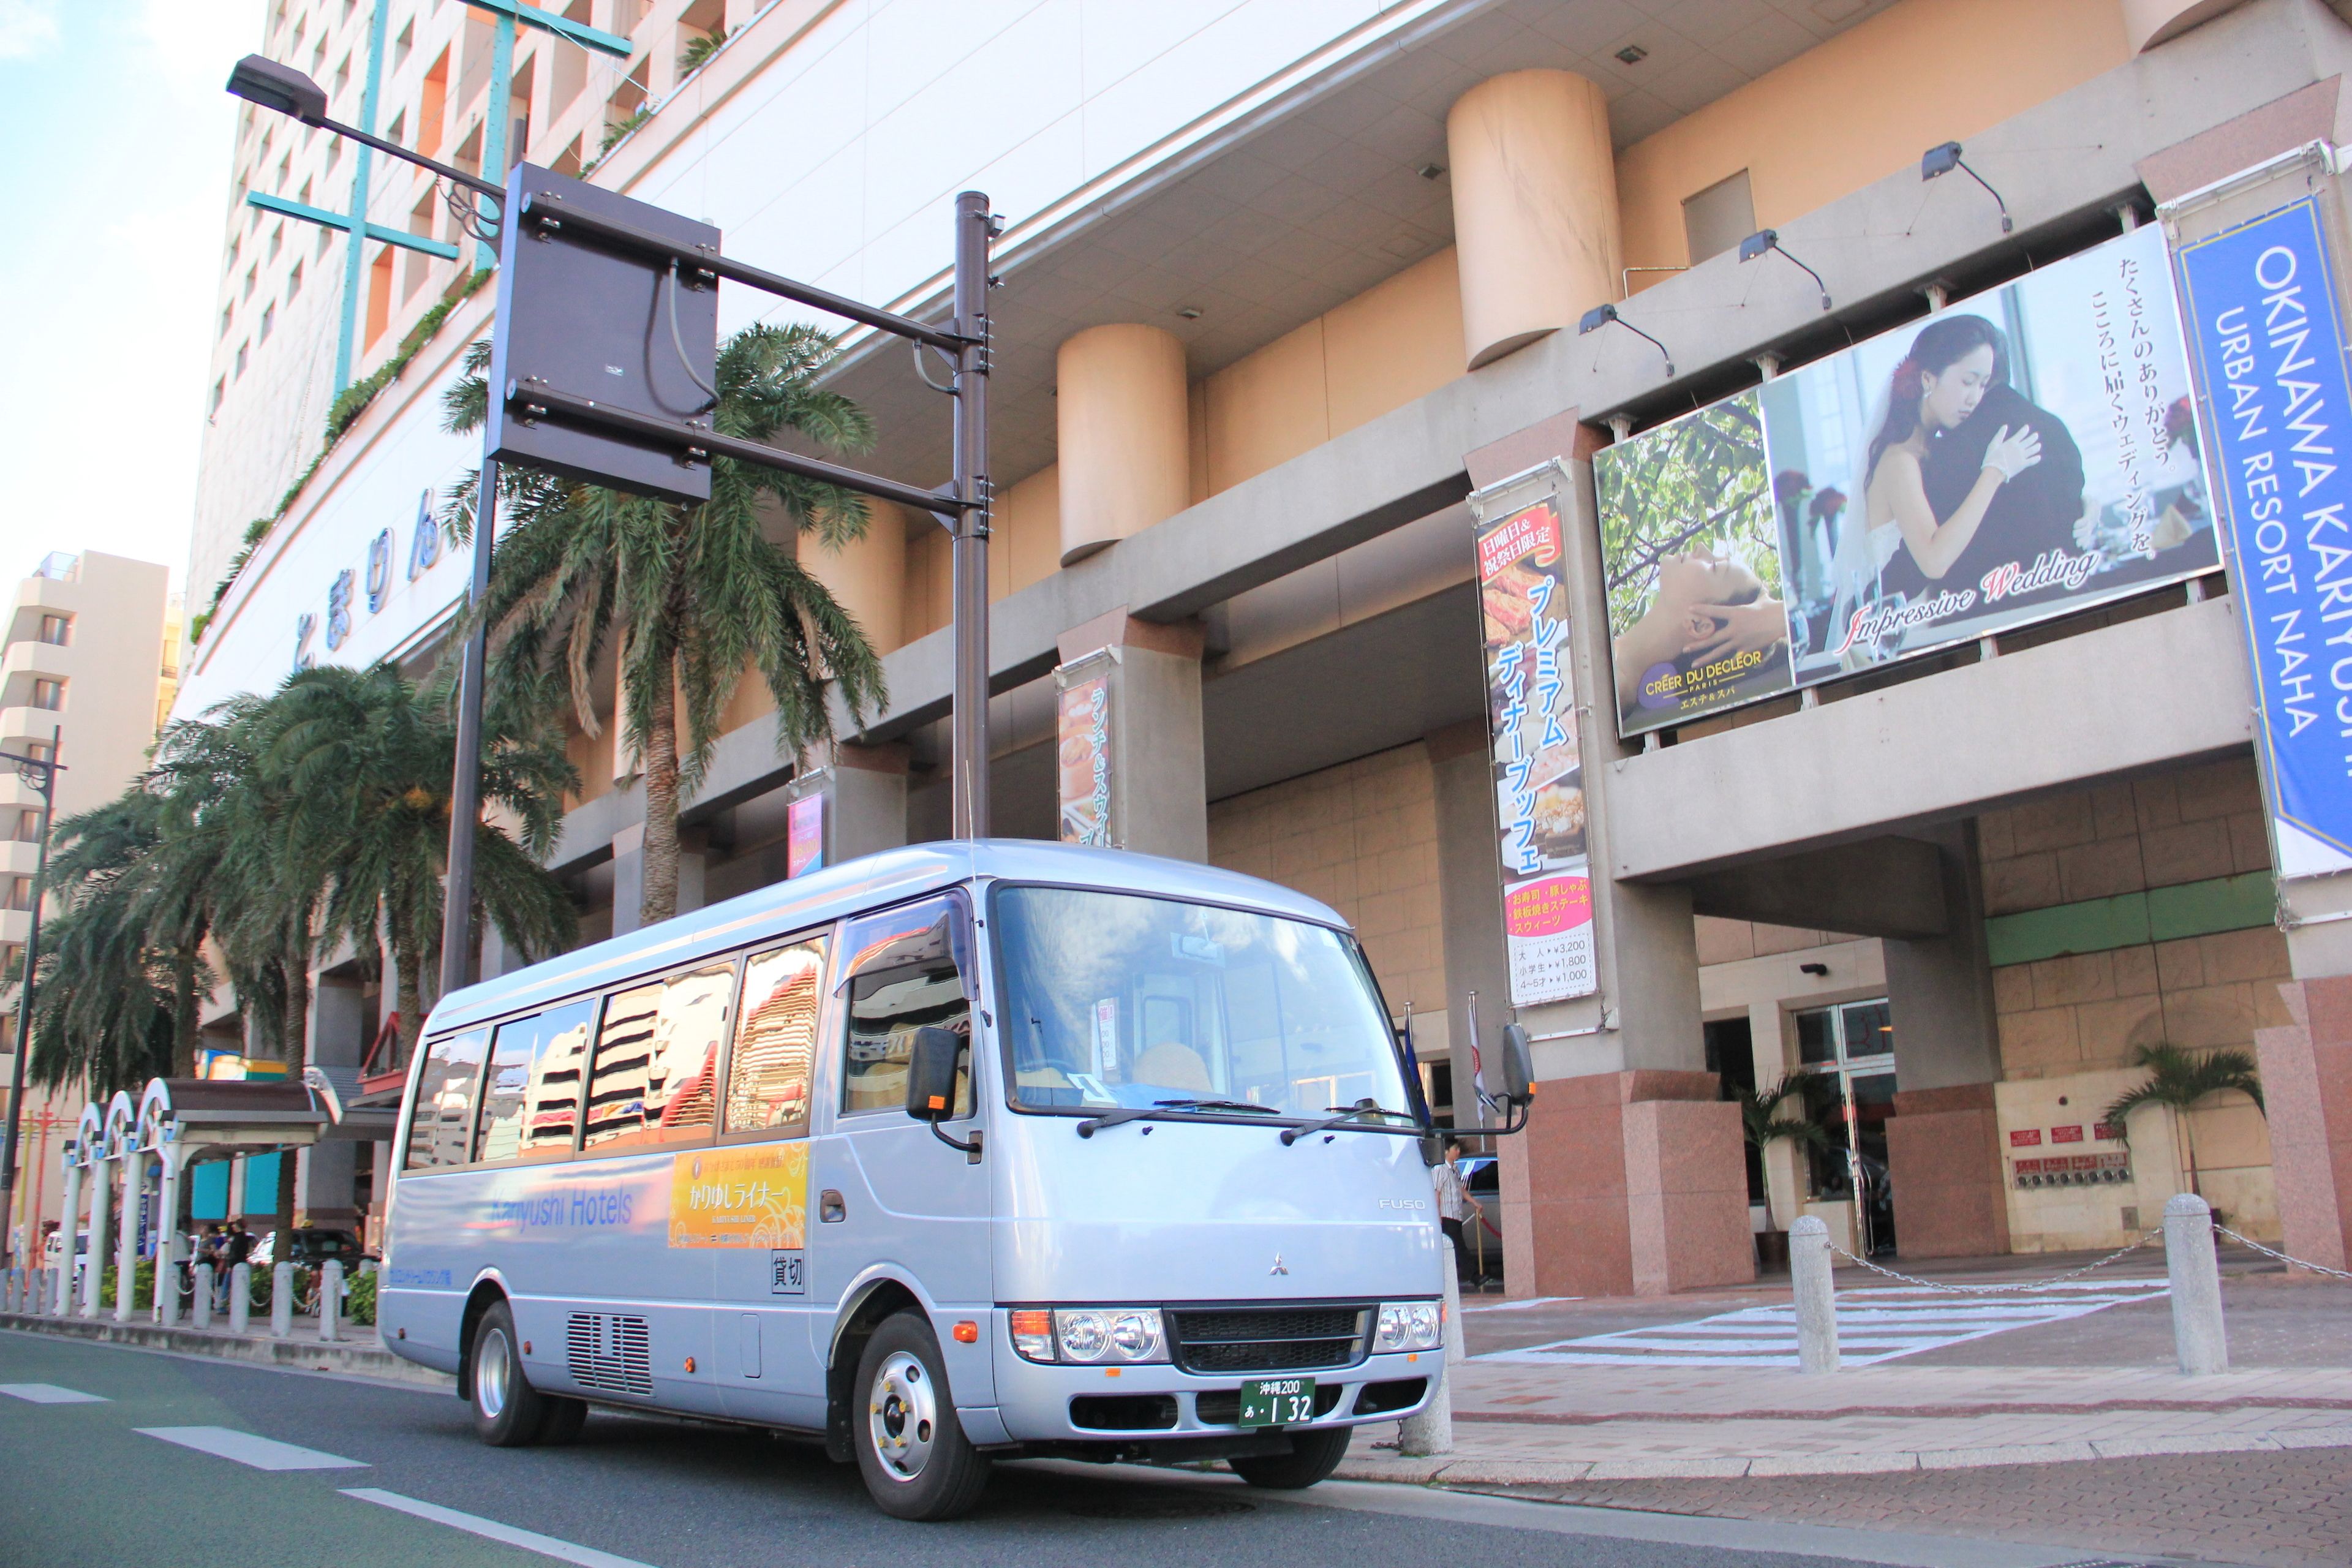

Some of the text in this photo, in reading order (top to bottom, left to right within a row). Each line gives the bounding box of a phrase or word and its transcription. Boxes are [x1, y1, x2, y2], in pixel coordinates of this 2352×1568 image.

[2119, 257, 2176, 473] たくさんのありがとう。
[2255, 246, 2337, 498] OKINAWA
[2092, 290, 2155, 560] こころに届くウェディングを。
[1483, 519, 1531, 557] 日曜日&
[2215, 305, 2319, 739] URBAN RESORT NAHA
[1484, 526, 1551, 577] 祝祭日限定
[1835, 548, 2100, 655] Impressive Wedding
[1528, 575, 1568, 749] プレミアム
[1686, 668, 1704, 685] DU
[1689, 679, 1718, 693] PARIS
[1498, 641, 1542, 875] ディナーブッフェ
[1554, 940, 1585, 954] ¥3,200
[1519, 955, 1586, 976] 小学生 ¥1,800
[1556, 969, 1588, 984] ¥1,000
[570, 1180, 633, 1226] Hotels
[690, 1181, 784, 1211] かりゆしライナー
[1378, 1199, 1426, 1210] FUSO
[773, 1256, 804, 1286] 貸切
[1259, 1380, 1300, 1395] 沖縄200
[1244, 1405, 1254, 1419] あ
